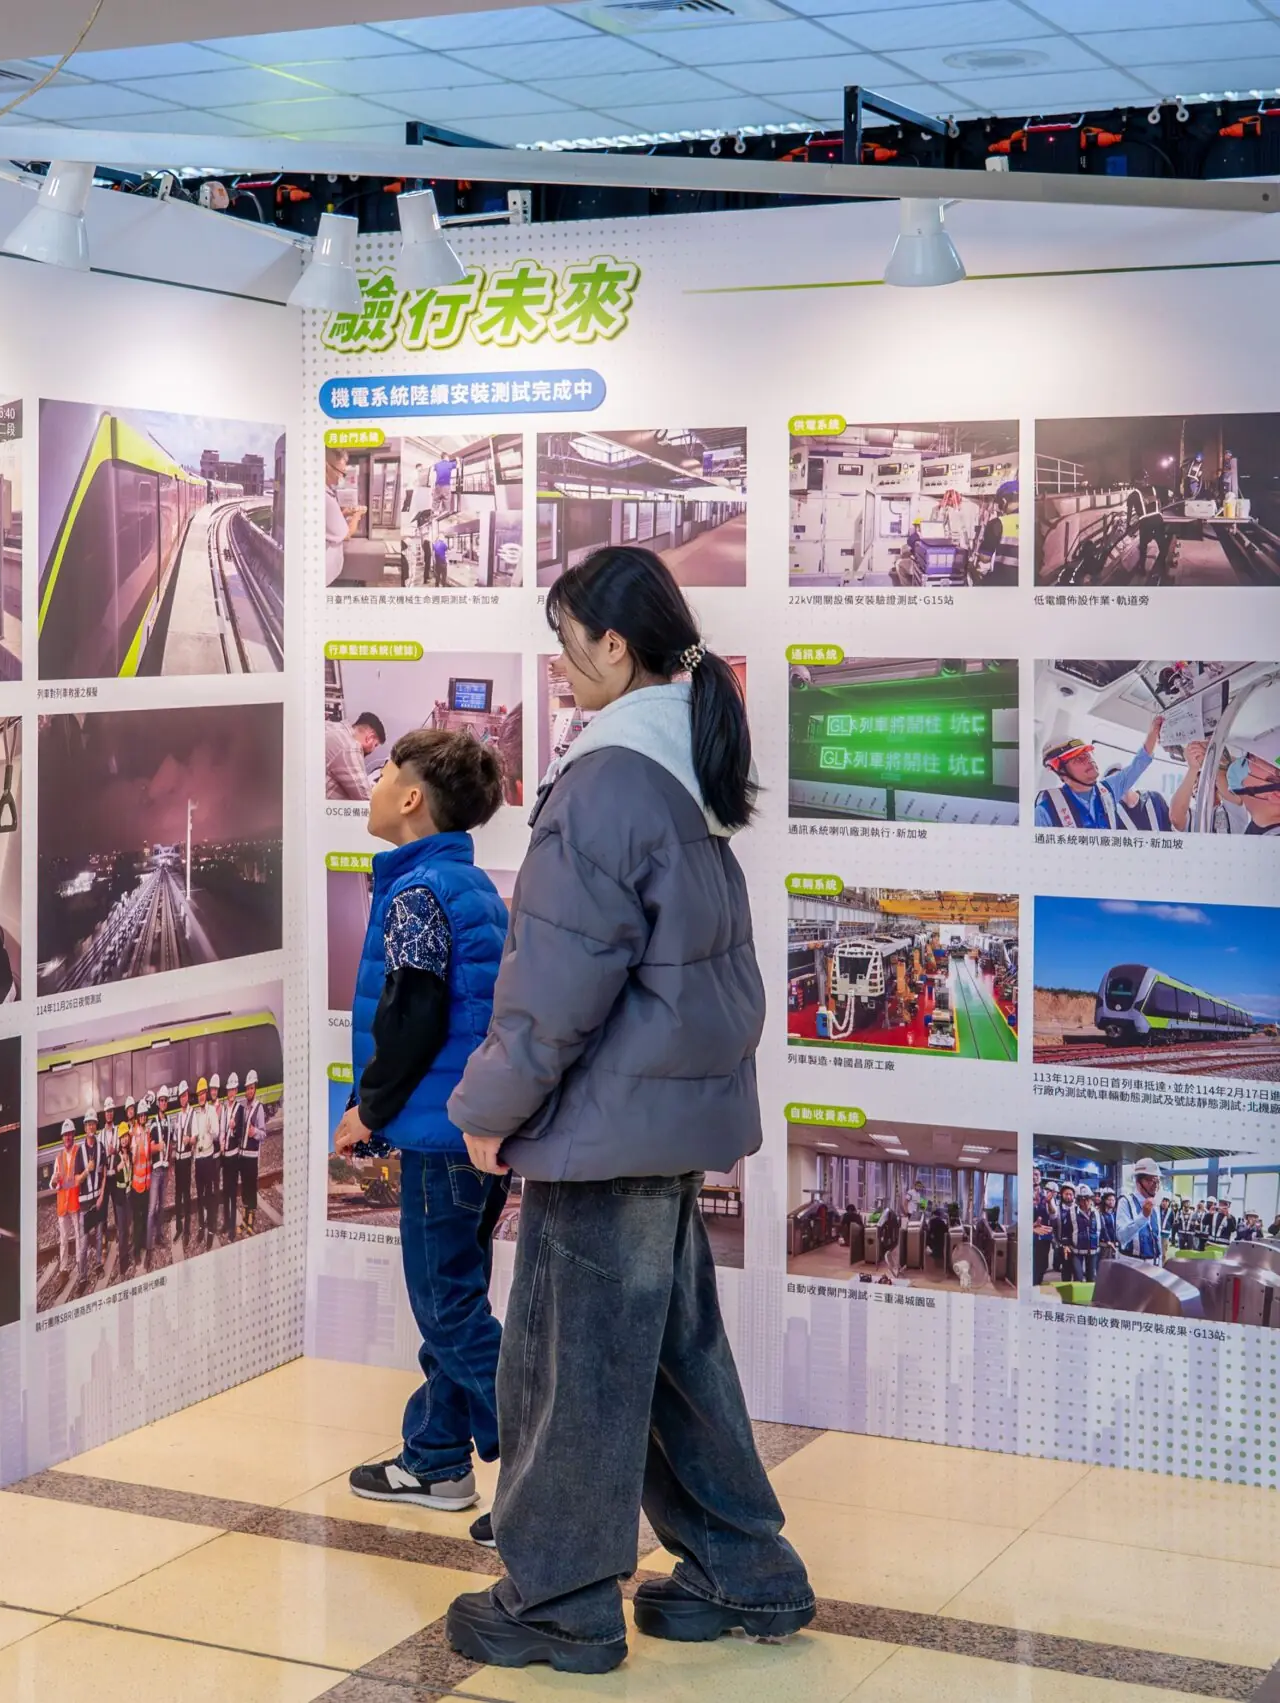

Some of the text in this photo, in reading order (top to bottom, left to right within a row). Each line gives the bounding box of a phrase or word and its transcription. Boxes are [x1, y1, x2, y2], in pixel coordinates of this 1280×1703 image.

[331, 378, 592, 409] 機電系統陸續安裝測試完成中
[793, 418, 840, 431] 供電系統
[791, 648, 838, 661] 通訊系統
[790, 1106, 860, 1124] 自動收費系統
